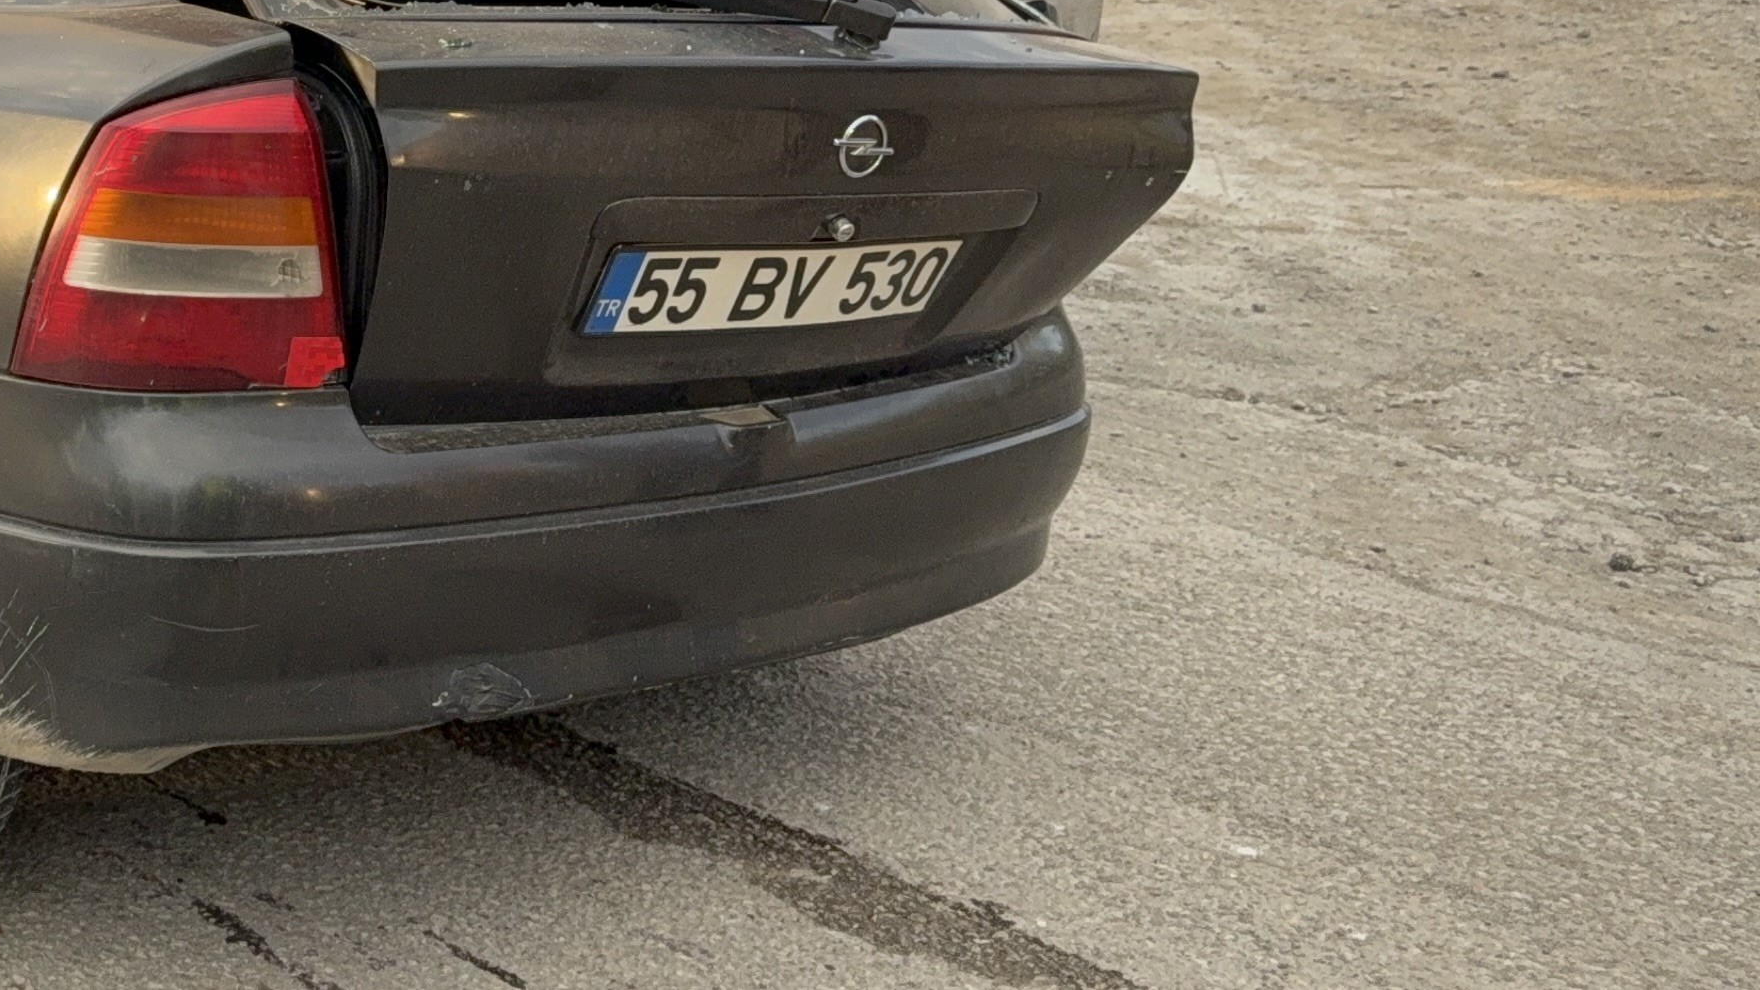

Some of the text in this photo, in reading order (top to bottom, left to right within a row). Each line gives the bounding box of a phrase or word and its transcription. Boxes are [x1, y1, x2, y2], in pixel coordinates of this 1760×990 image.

[596, 246, 949, 325] TR 55 BV 530
